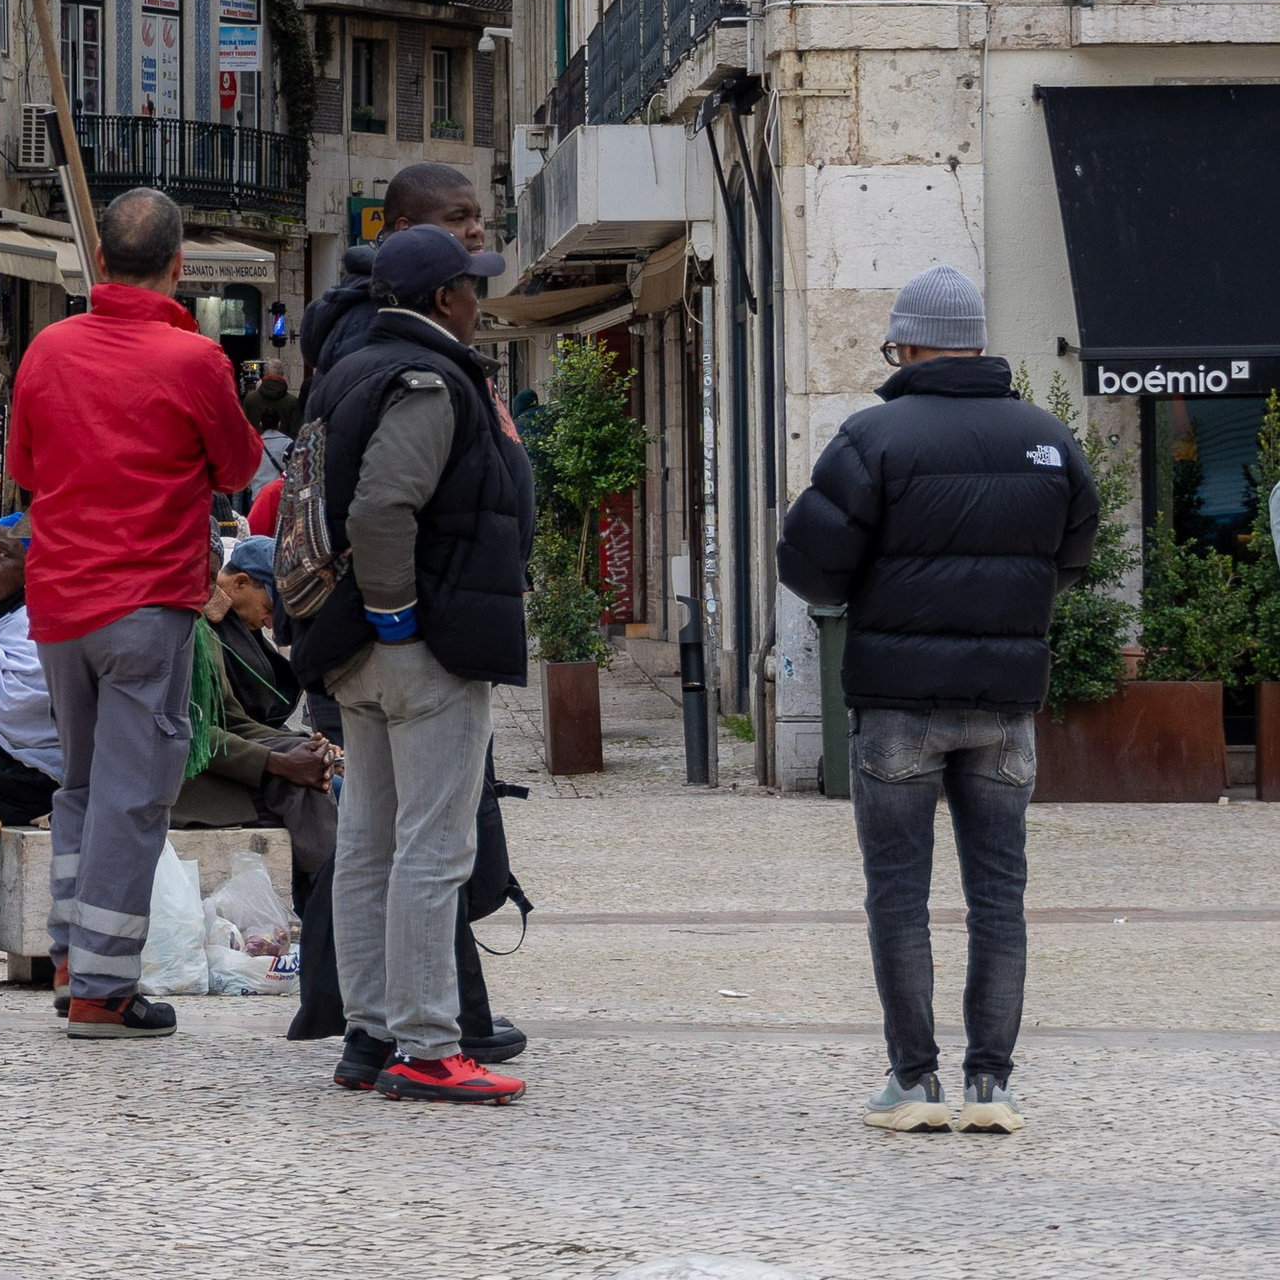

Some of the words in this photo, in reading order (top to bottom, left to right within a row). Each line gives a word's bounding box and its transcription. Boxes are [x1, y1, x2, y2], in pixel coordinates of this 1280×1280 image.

[183, 265, 214, 277] ESANATO
[220, 265, 267, 277] MINI-MERCADO
[1098, 365, 1228, 393] boémio
